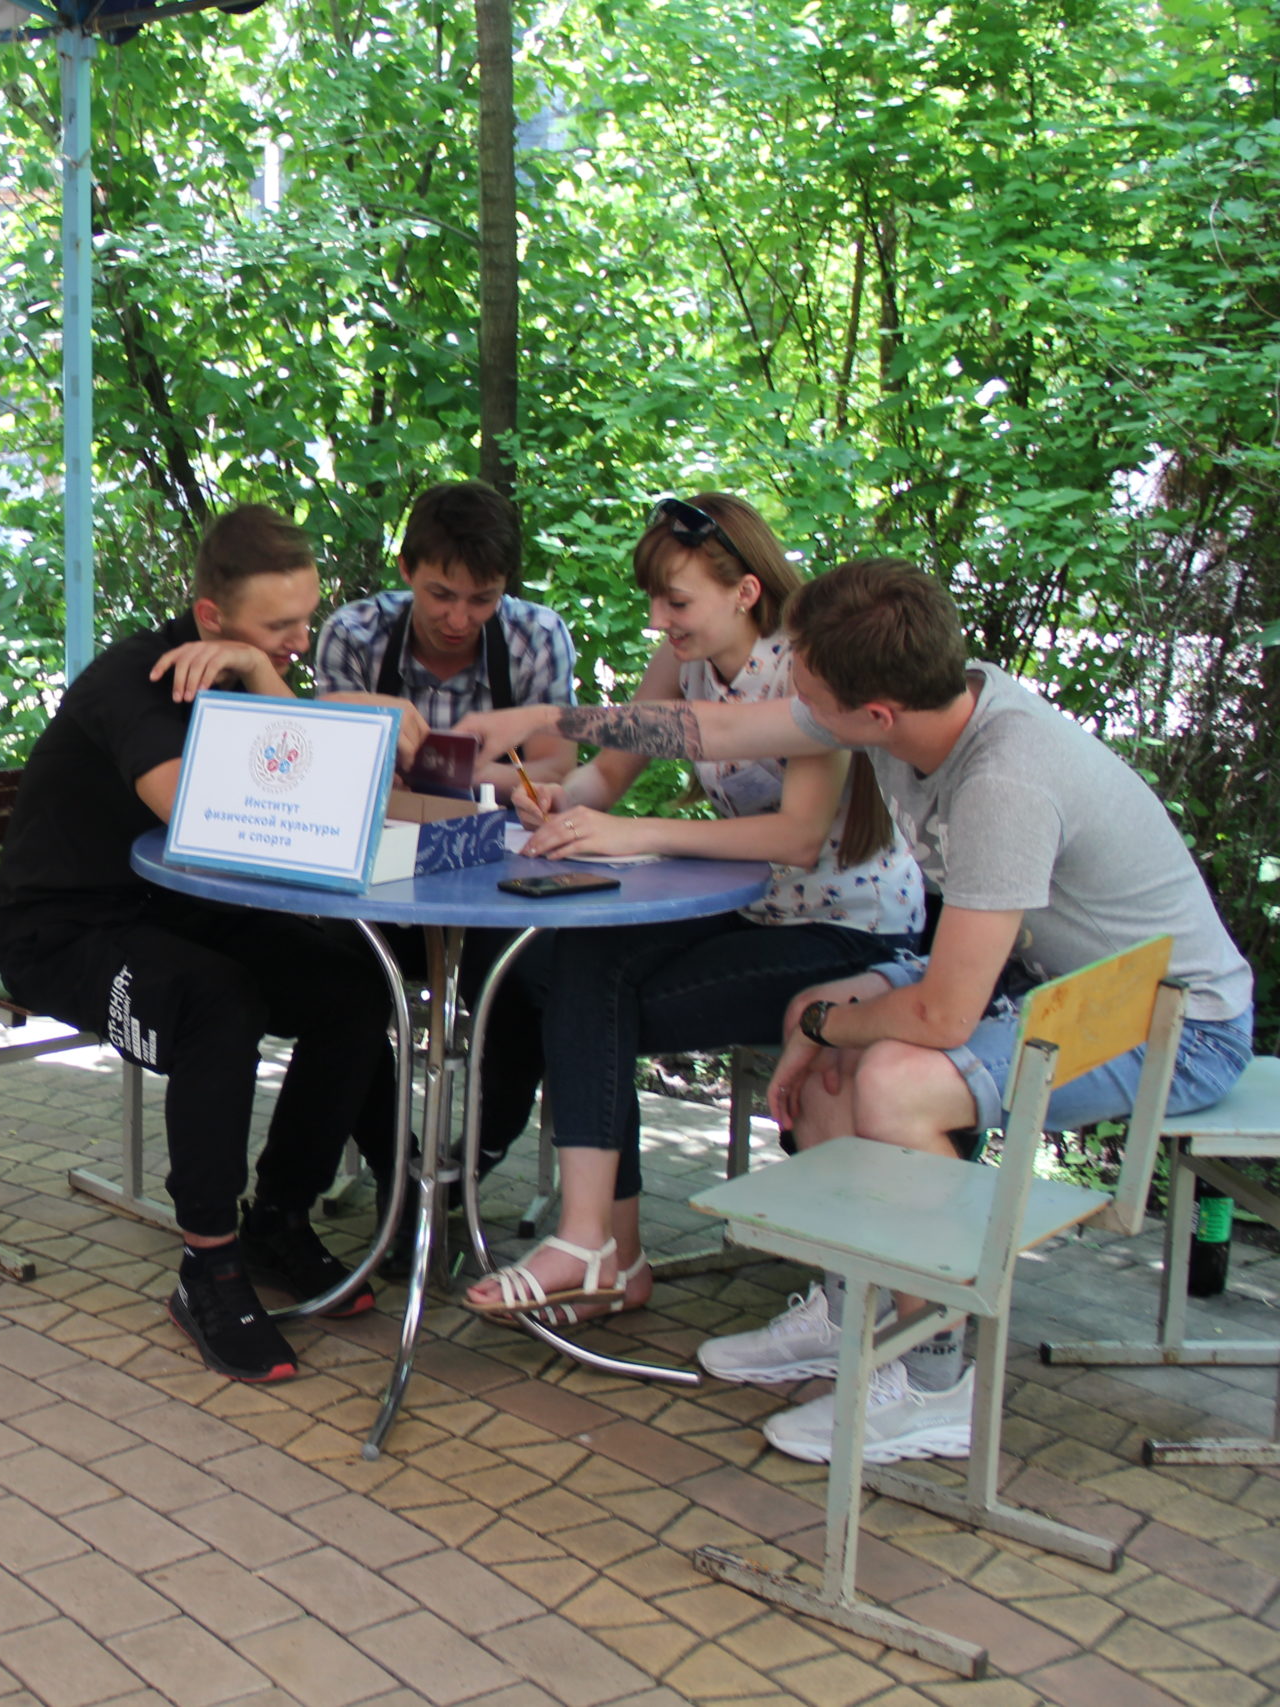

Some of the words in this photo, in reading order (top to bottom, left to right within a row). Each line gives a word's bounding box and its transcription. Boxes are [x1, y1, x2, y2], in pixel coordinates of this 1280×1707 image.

[244, 796, 301, 814] Институт
[204, 807, 276, 828] физической
[280, 817, 341, 837] культуры
[238, 830, 246, 840] и
[249, 831, 292, 847] спорта
